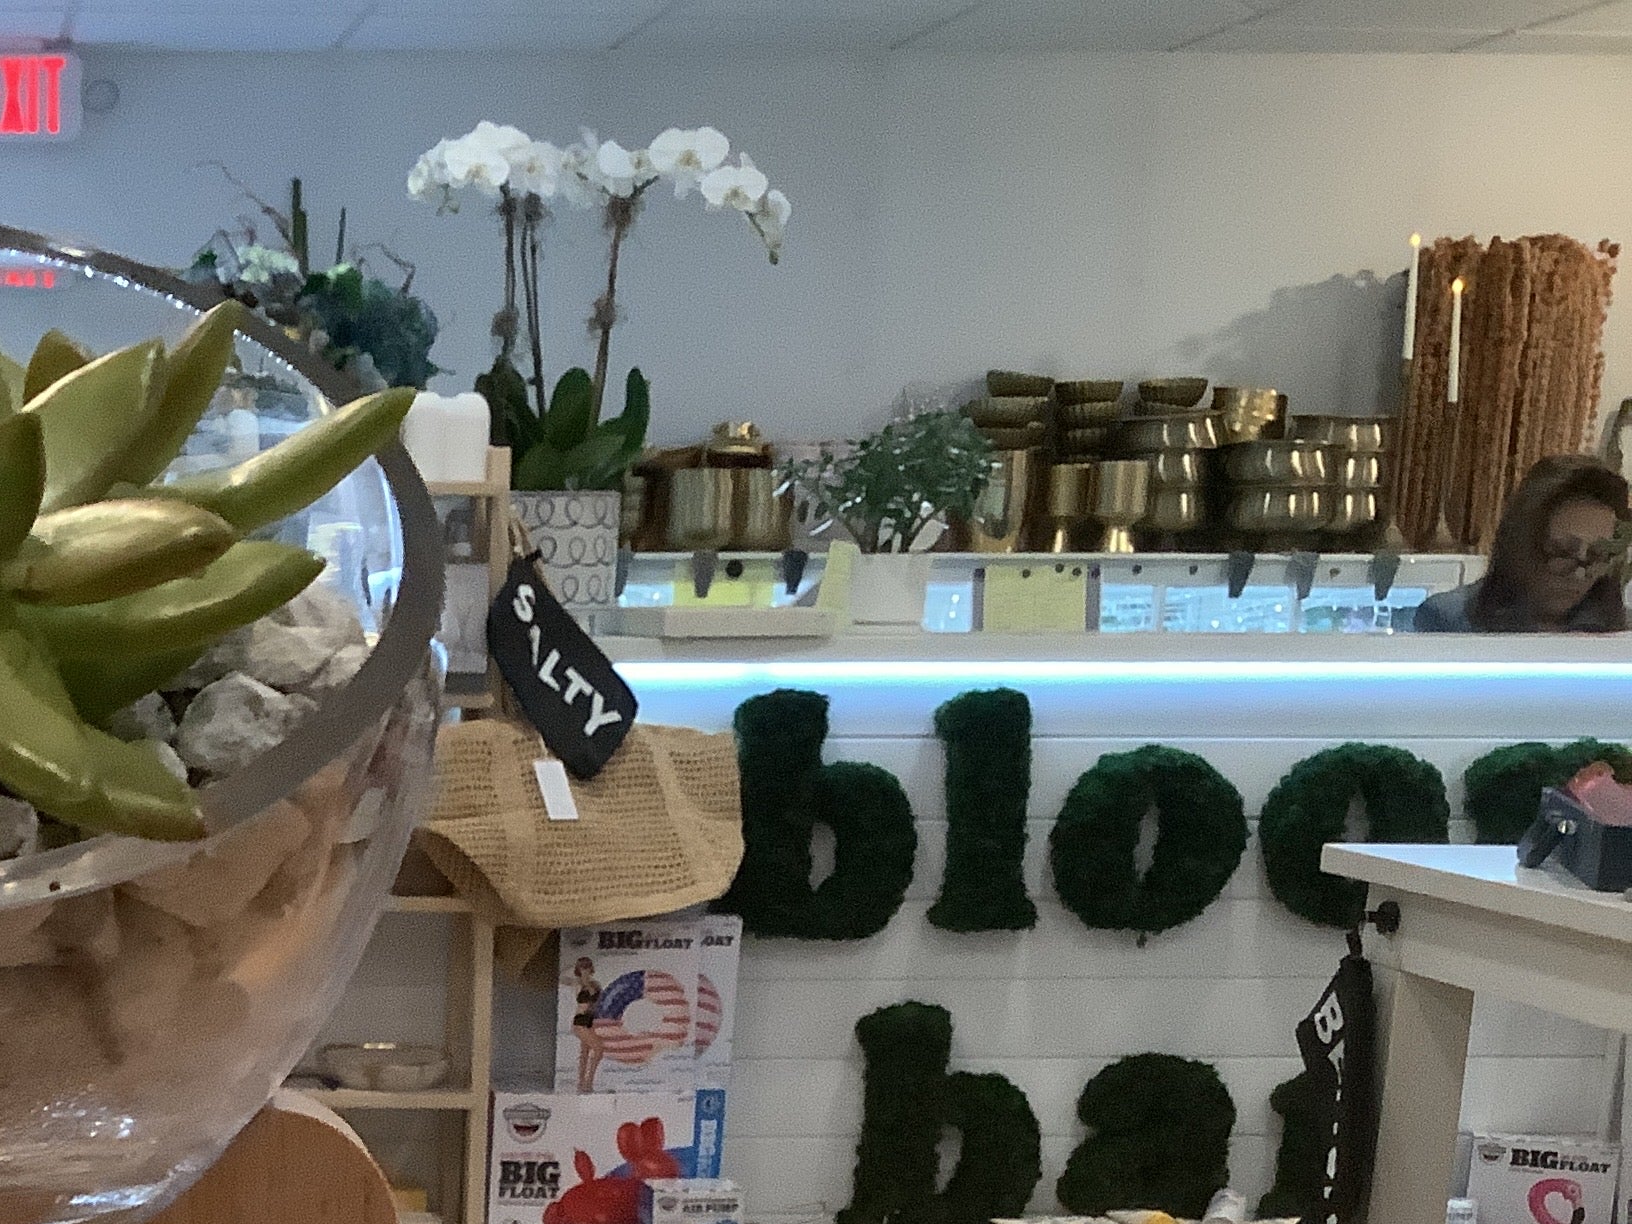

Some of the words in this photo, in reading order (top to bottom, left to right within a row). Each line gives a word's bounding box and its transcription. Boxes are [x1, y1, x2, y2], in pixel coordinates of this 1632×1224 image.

[597, 930, 643, 950] BIG
[644, 937, 694, 950] FLOAT
[700, 935, 735, 947] OAT
[1509, 1147, 1558, 1169] BIG
[1558, 1158, 1612, 1174] FLOAT
[499, 1160, 561, 1185] BIG
[498, 1185, 561, 1199] FLOAT
